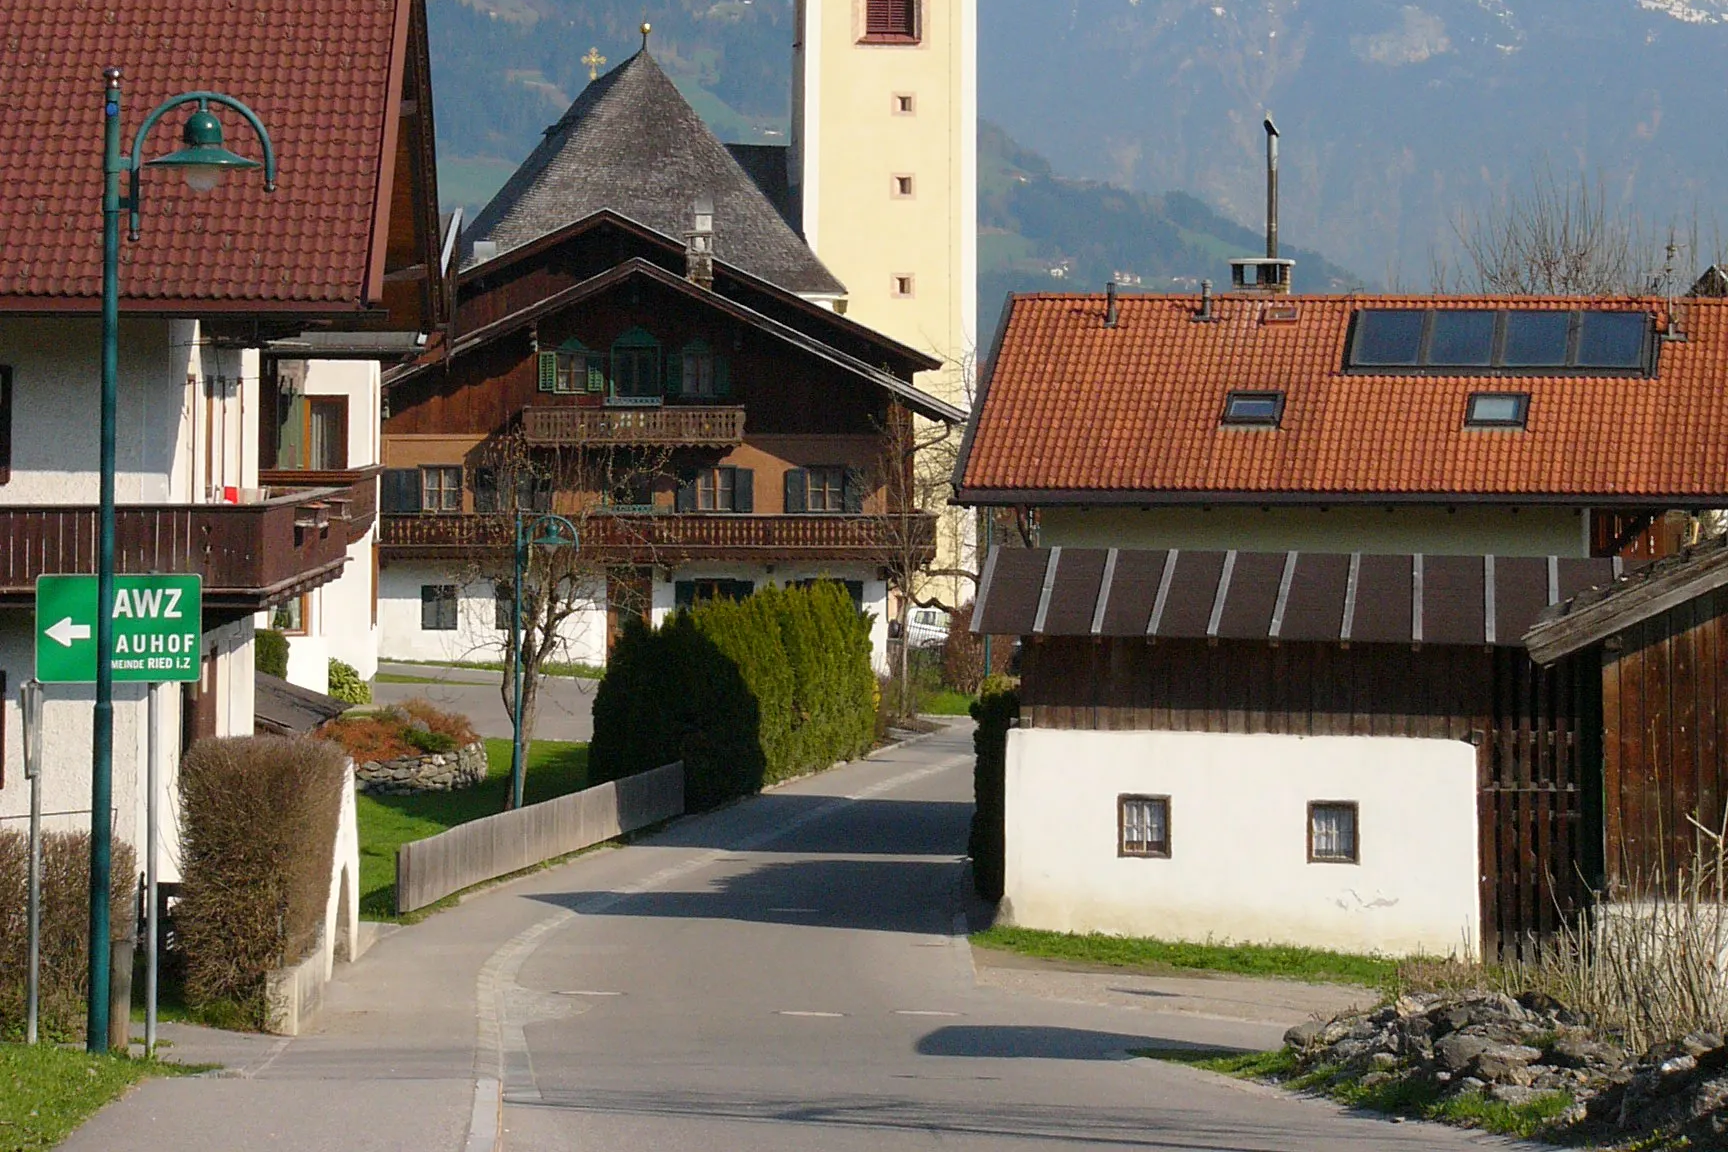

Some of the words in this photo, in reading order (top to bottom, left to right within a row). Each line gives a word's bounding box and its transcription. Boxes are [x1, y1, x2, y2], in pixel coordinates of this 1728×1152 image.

[112, 588, 182, 618] AWZ
[115, 634, 195, 653] AUHOF
[111, 659, 144, 669] MEINDE
[147, 657, 173, 669] RIED
